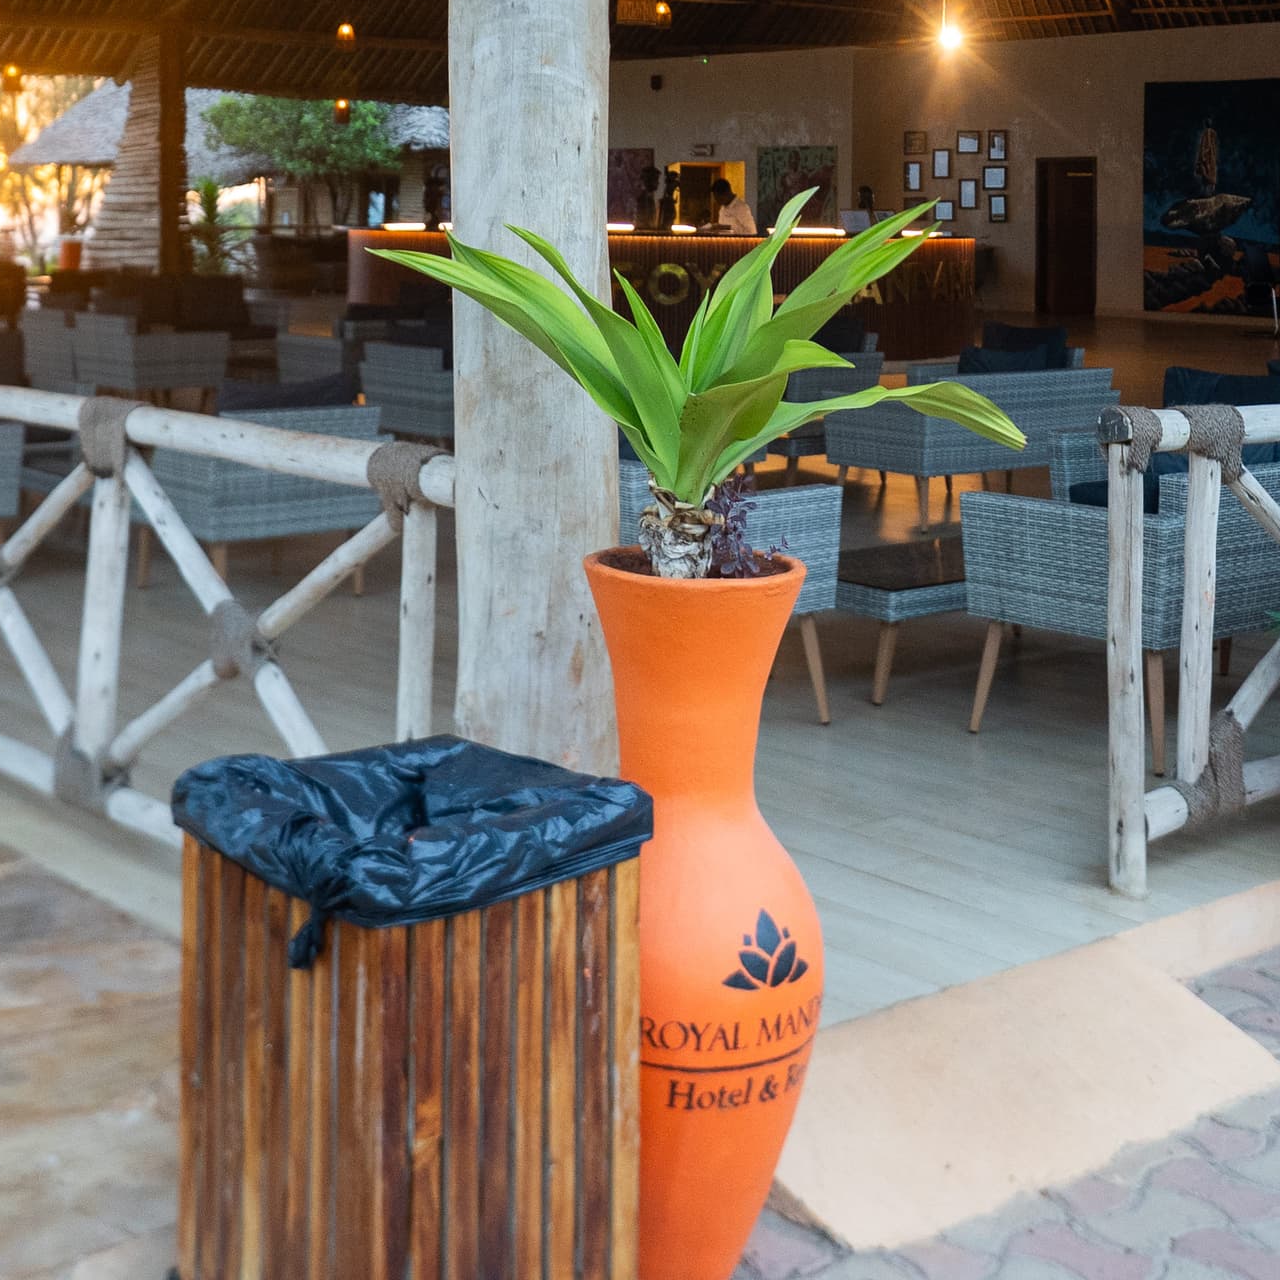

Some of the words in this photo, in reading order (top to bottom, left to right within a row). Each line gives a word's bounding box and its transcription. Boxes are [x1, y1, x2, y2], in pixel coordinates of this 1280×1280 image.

[640, 1015, 748, 1052] ROYAL
[666, 1076, 754, 1111] Hotel
[758, 1073, 780, 1103] &
